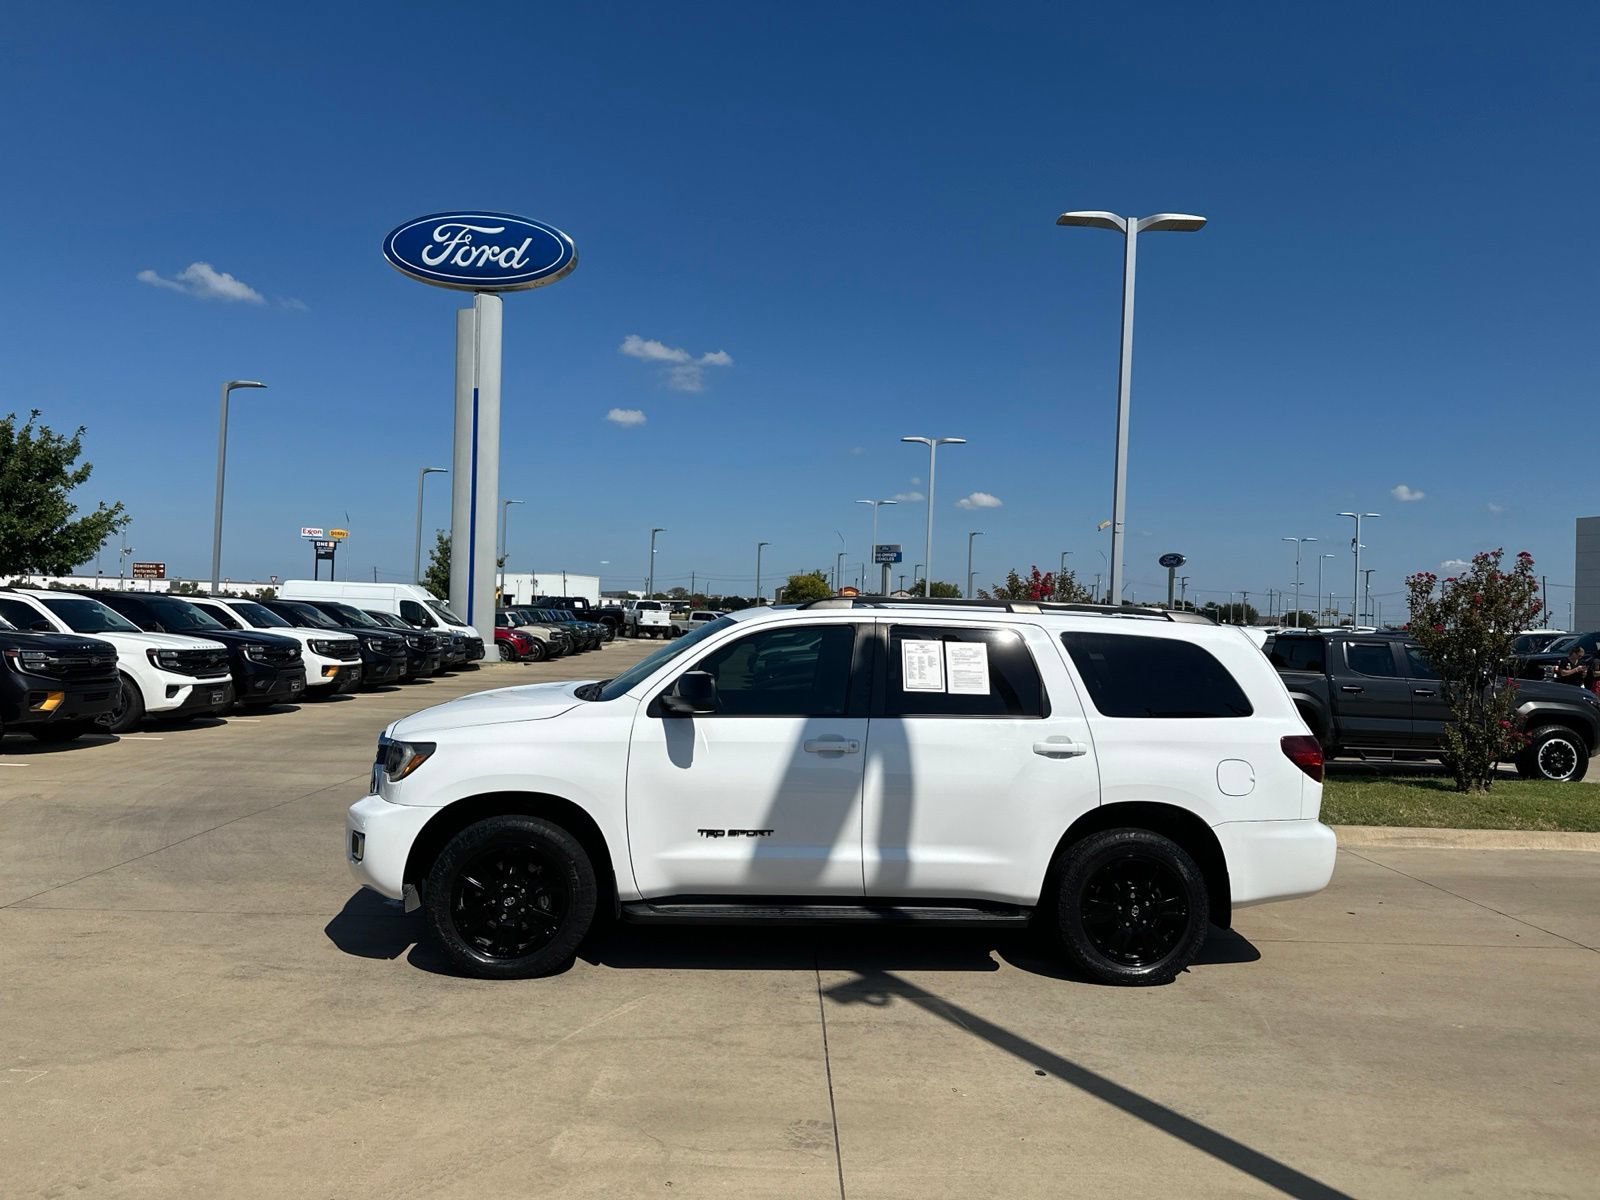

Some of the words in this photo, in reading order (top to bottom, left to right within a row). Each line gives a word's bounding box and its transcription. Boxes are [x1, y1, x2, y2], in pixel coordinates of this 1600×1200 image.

[421, 223, 533, 269] Ford
[302, 528, 322, 536] Exxon
[697, 829, 725, 838] TRD
[727, 829, 774, 837] SPORT
